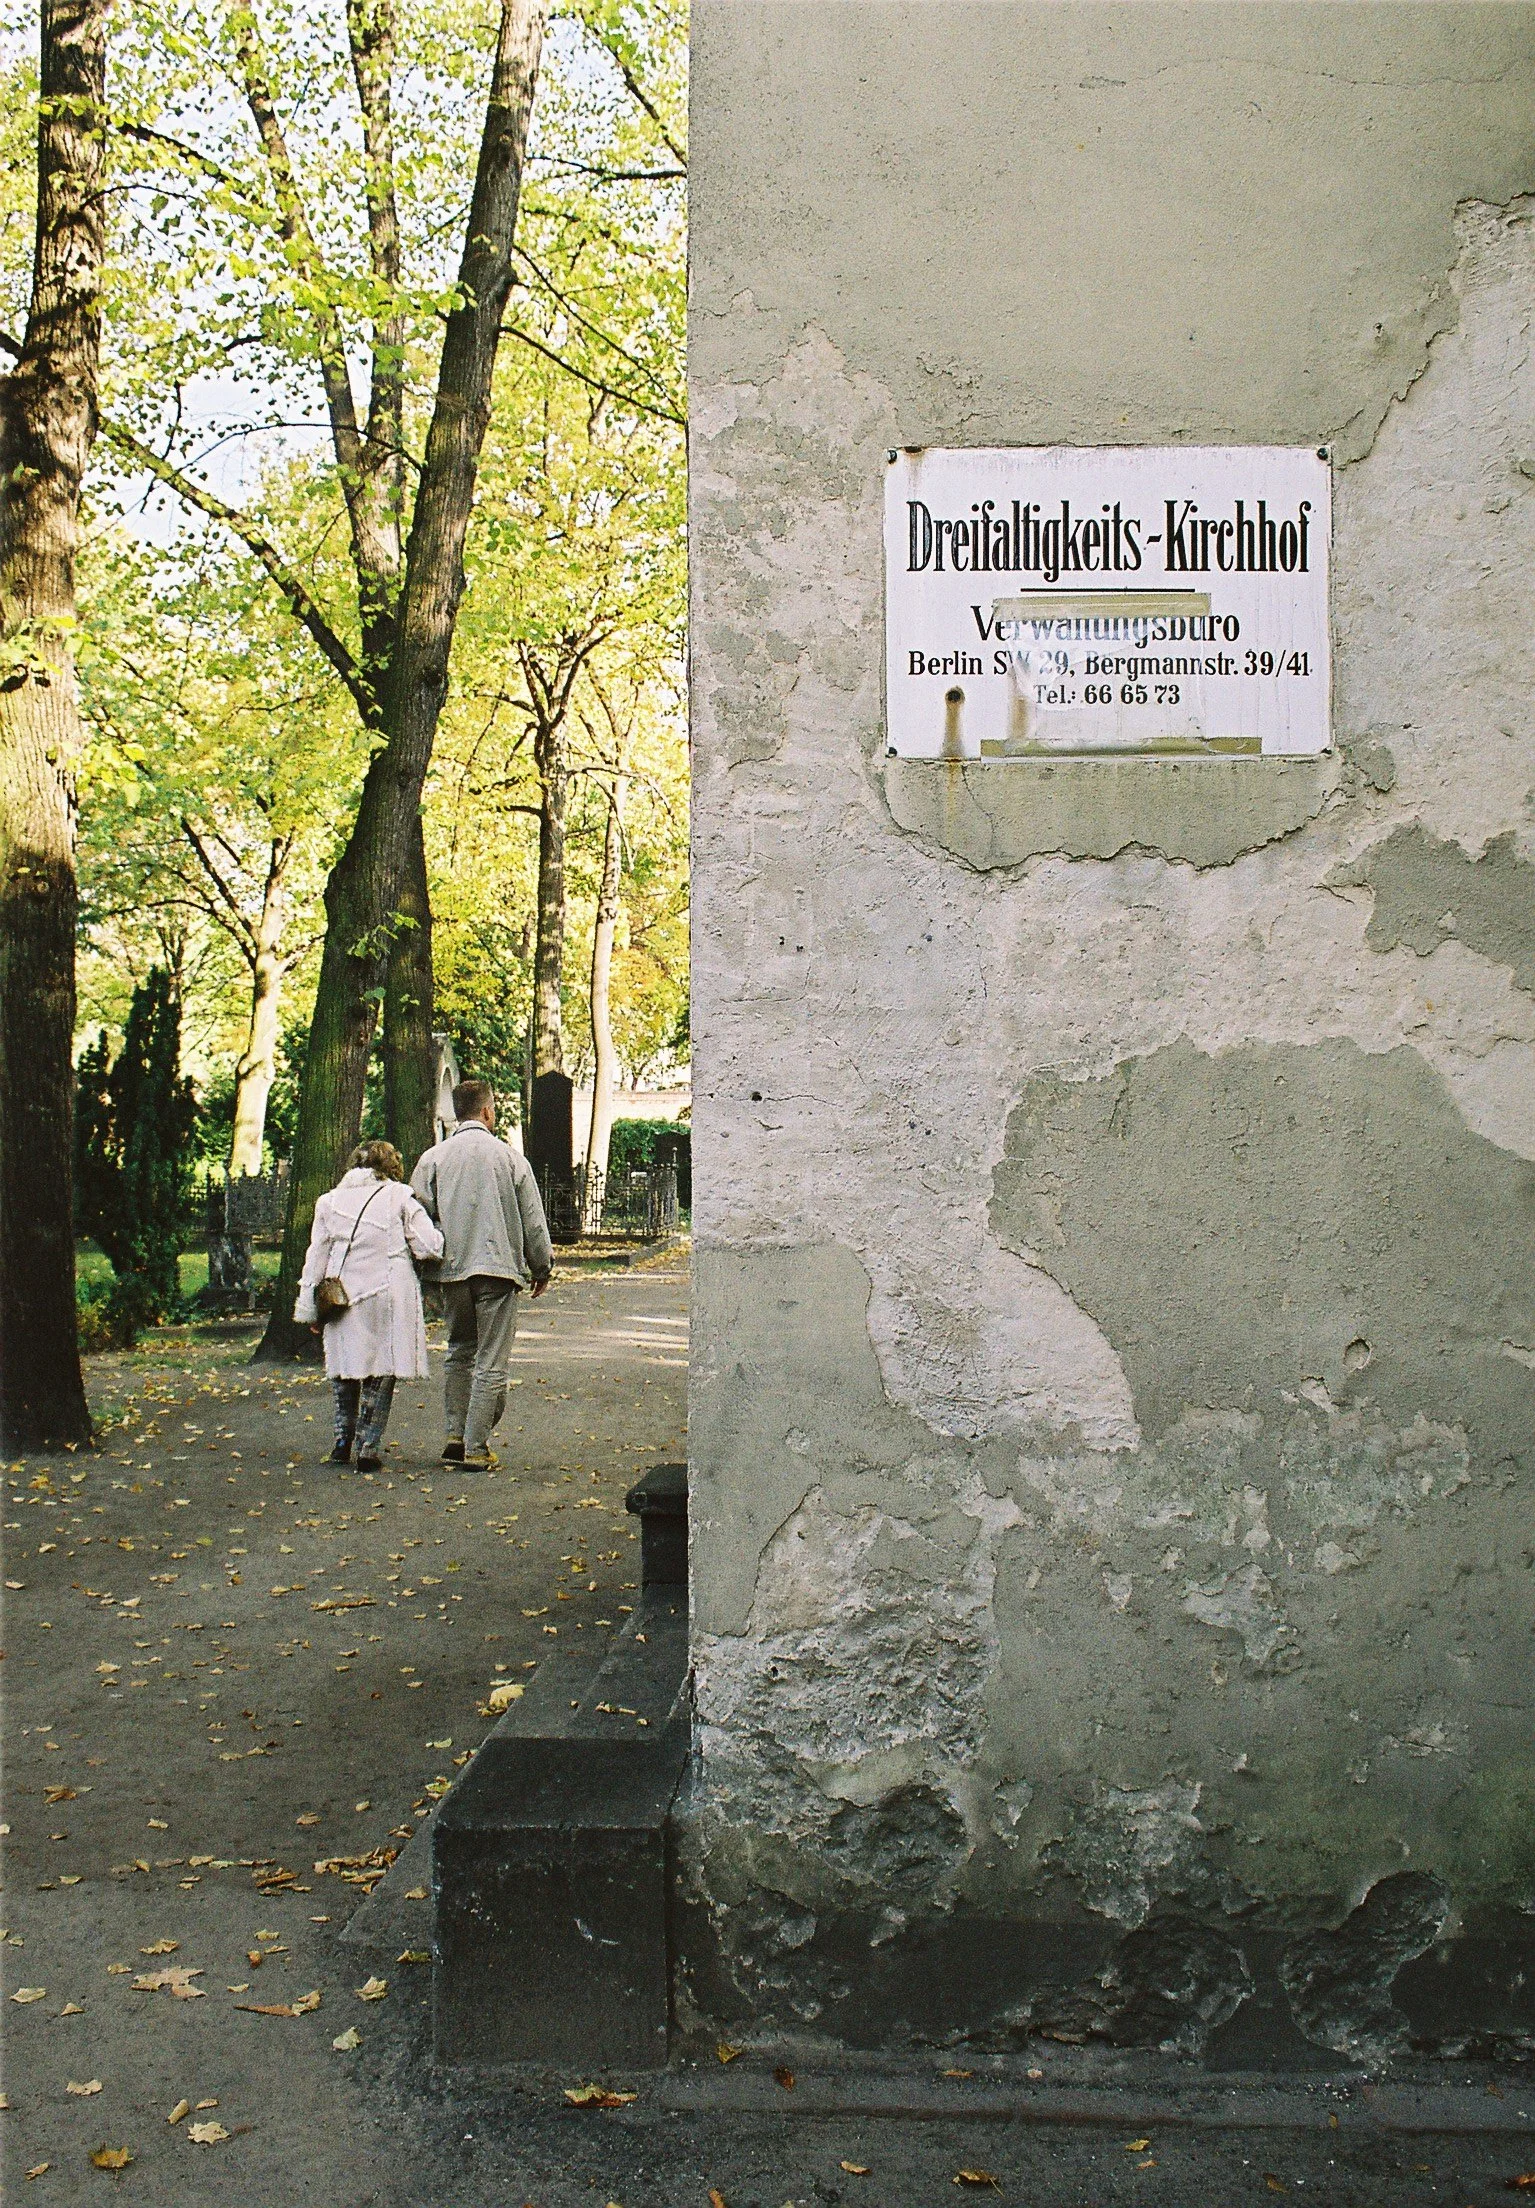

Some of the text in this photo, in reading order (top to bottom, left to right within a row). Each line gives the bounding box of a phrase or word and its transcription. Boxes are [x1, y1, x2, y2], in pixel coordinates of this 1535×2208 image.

[906, 500, 1314, 582] Dreifaltigkeits-Kirchhof
[908, 649, 1311, 682] Berlin SW 29, Bergmannstr. 39/41
[1084, 684, 1113, 705] 66
[1120, 684, 1149, 705] 65
[1153, 684, 1181, 705] 73
